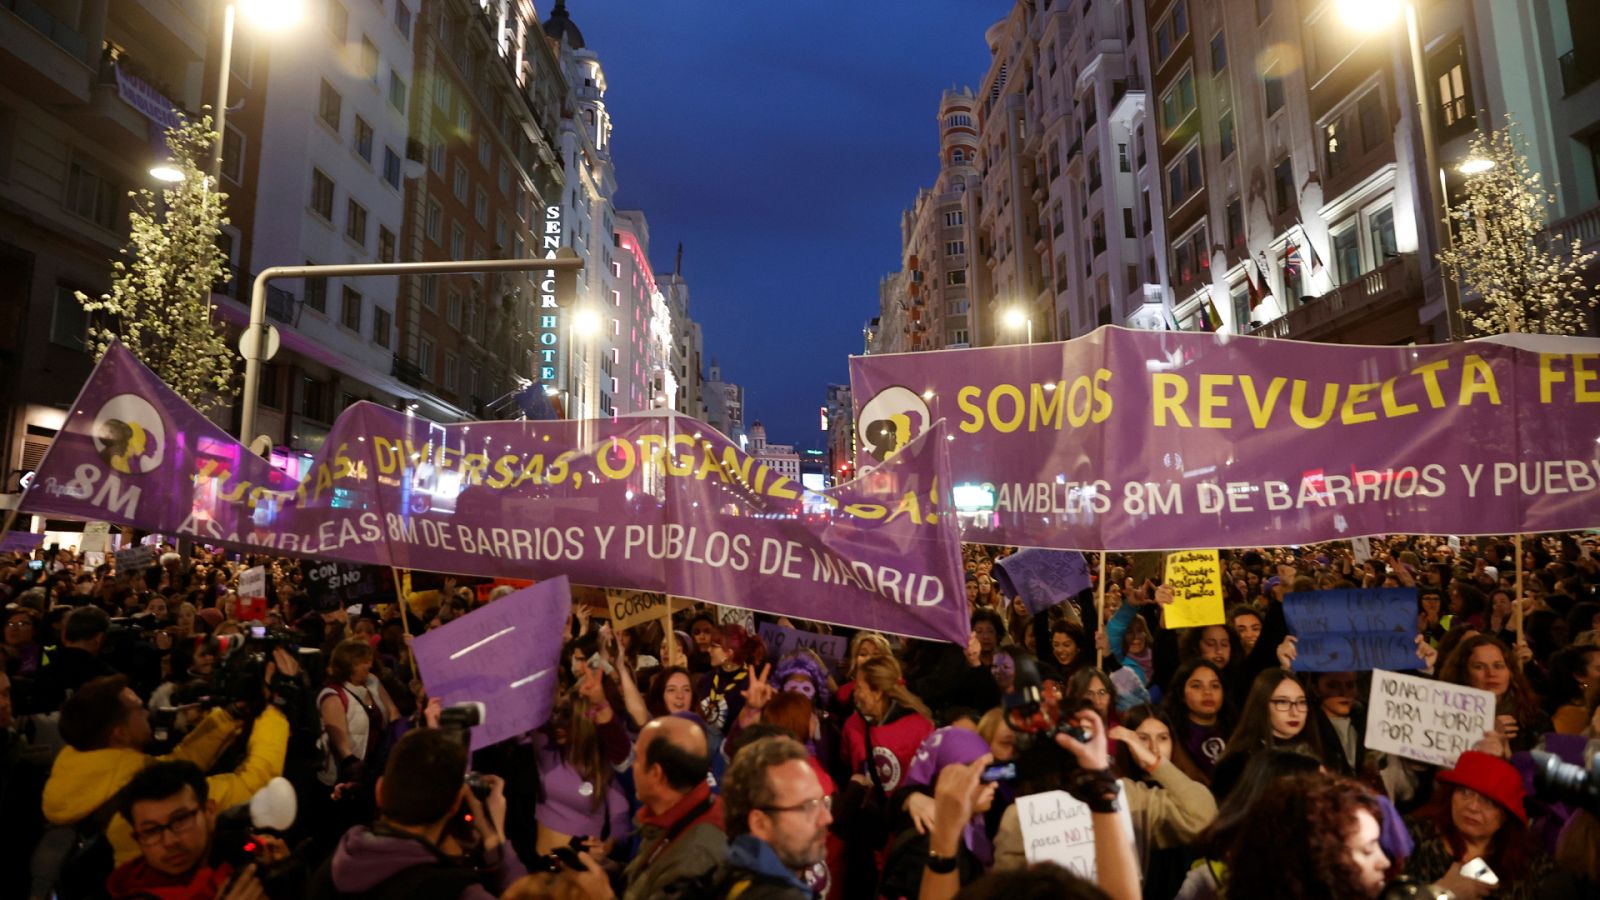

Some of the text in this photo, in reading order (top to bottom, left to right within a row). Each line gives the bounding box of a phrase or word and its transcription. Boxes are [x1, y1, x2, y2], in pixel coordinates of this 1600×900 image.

[957, 368, 1113, 433] SOMOS
[1152, 355, 1501, 429] REVUELTA
[66, 463, 142, 519] 8M
[1123, 480, 1184, 515] 8M
[1196, 481, 1254, 513] DE
[1263, 463, 1447, 511] BARRIOS
[1460, 463, 1484, 497] Y
[387, 513, 420, 546] 8M
[422, 519, 456, 551] DE
[458, 525, 585, 561] BARRIOS
[594, 526, 616, 560] Y
[759, 537, 803, 579] DE
[809, 548, 944, 606] MADRID
[309, 563, 338, 581] CON
[343, 571, 361, 586] NO
[1380, 678, 1398, 697] NO
[1385, 700, 1422, 723] PARA
[1378, 720, 1413, 743] POR
[1064, 827, 1081, 843] NO
